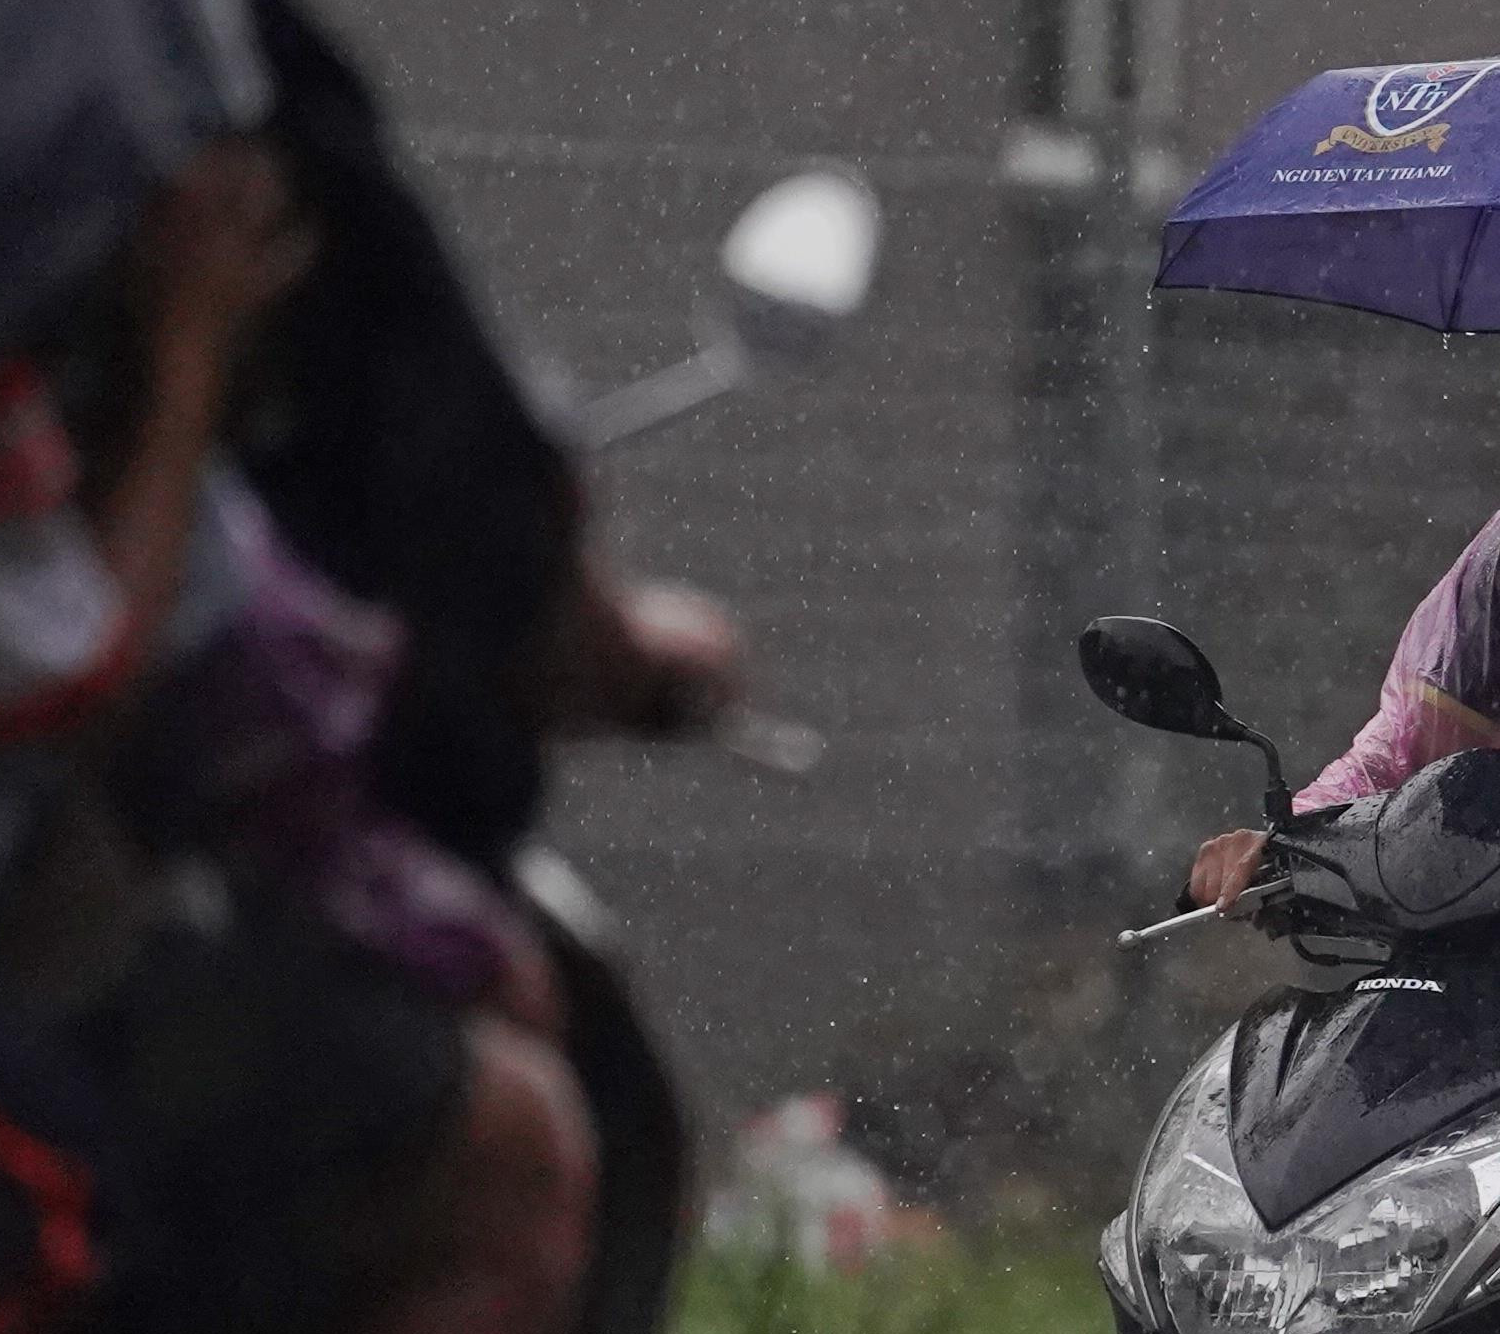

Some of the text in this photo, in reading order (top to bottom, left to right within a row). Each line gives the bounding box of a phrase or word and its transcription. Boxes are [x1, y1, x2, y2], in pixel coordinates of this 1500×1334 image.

[1379, 82, 1449, 111] NTT
[1341, 128, 1432, 152] UNIVERSI
[1271, 165, 1452, 183] NGUYEN TAT THANH
[1355, 978, 1443, 994] HONDA
